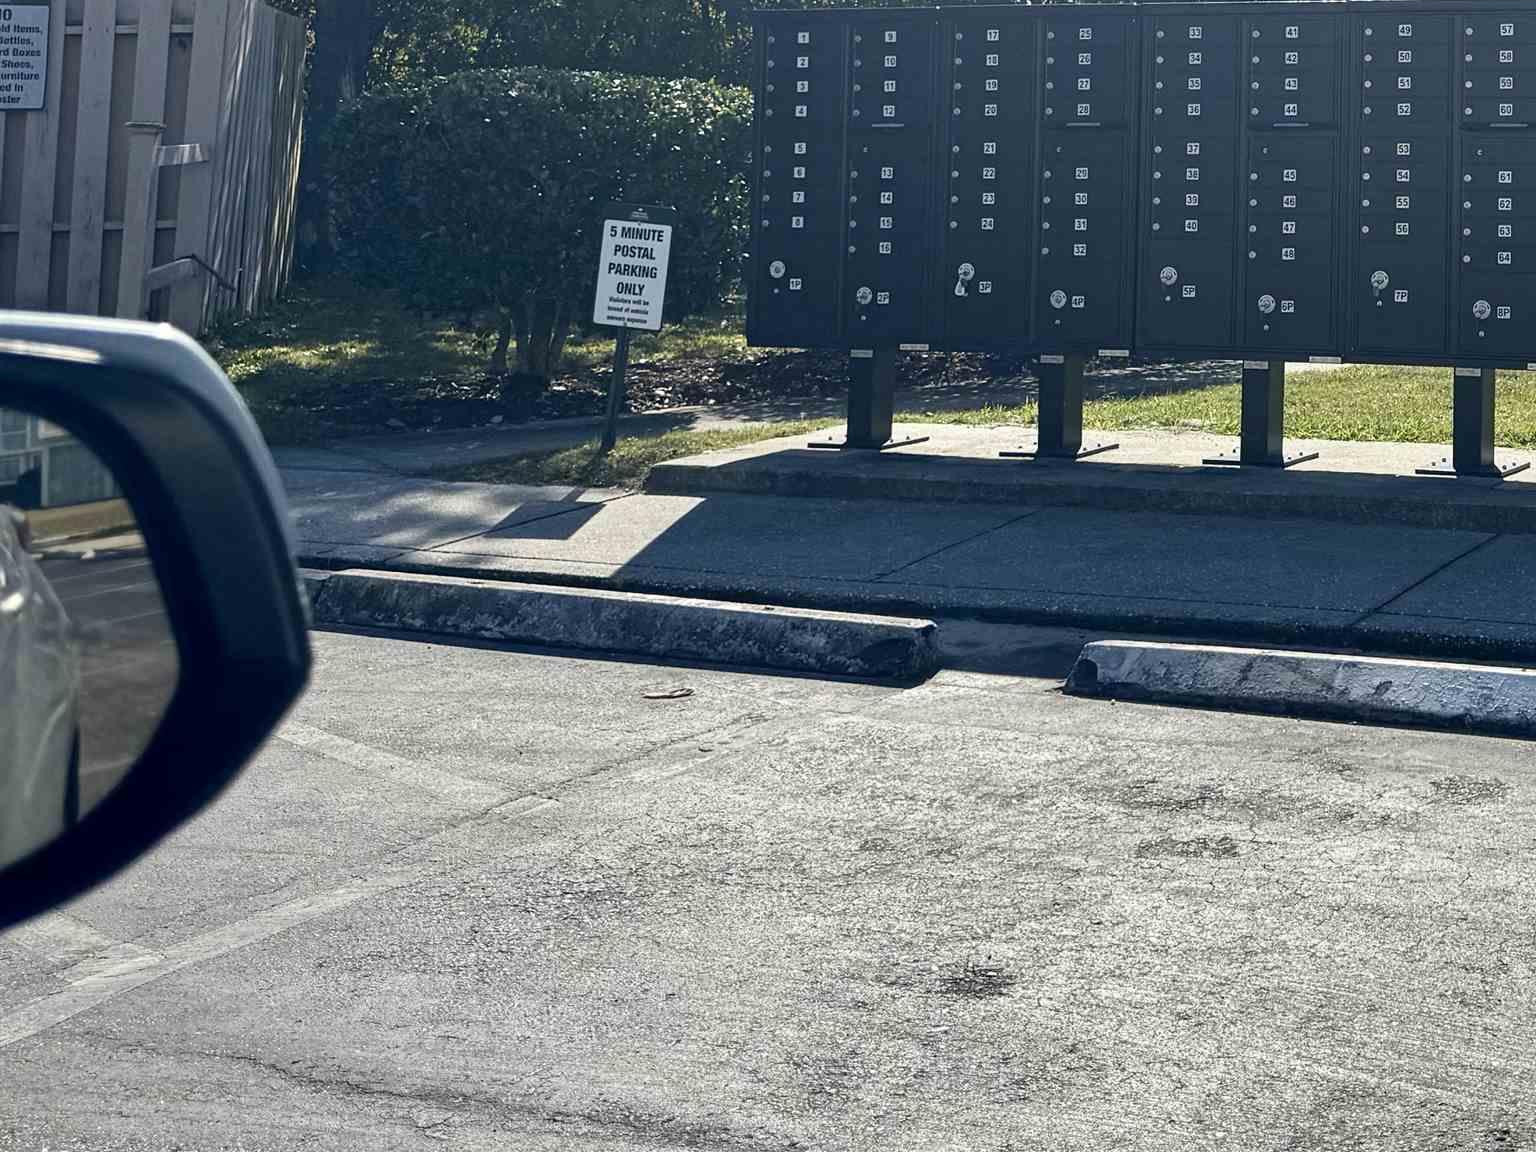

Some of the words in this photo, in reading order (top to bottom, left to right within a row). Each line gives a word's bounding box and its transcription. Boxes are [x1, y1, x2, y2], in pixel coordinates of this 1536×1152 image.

[0, 9, 12, 21] O
[1400, 25, 1410, 35] 49
[1501, 25, 1512, 34] 57
[13, 47, 41, 57] Boxes
[1400, 52, 1410, 61] 50
[1501, 52, 1511, 61] 58
[0, 71, 40, 81] urniture
[1399, 78, 1410, 87] 51
[1501, 78, 1511, 88] 59
[1399, 104, 1409, 114] 52
[1501, 105, 1511, 114] 60
[1398, 144, 1409, 154] 53
[1398, 171, 1408, 180] 54
[1500, 172, 1511, 182] 61
[1397, 198, 1408, 207] 55
[1499, 199, 1510, 209] 62
[610, 226, 617, 237] 5
[621, 227, 665, 242] MINUTE
[1397, 224, 1407, 234] 56
[1499, 226, 1510, 236] 63
[614, 244, 656, 260] POSTAL
[1499, 253, 1510, 263] 64
[608, 262, 658, 279] PARKING
[616, 281, 645, 297] ONLY
